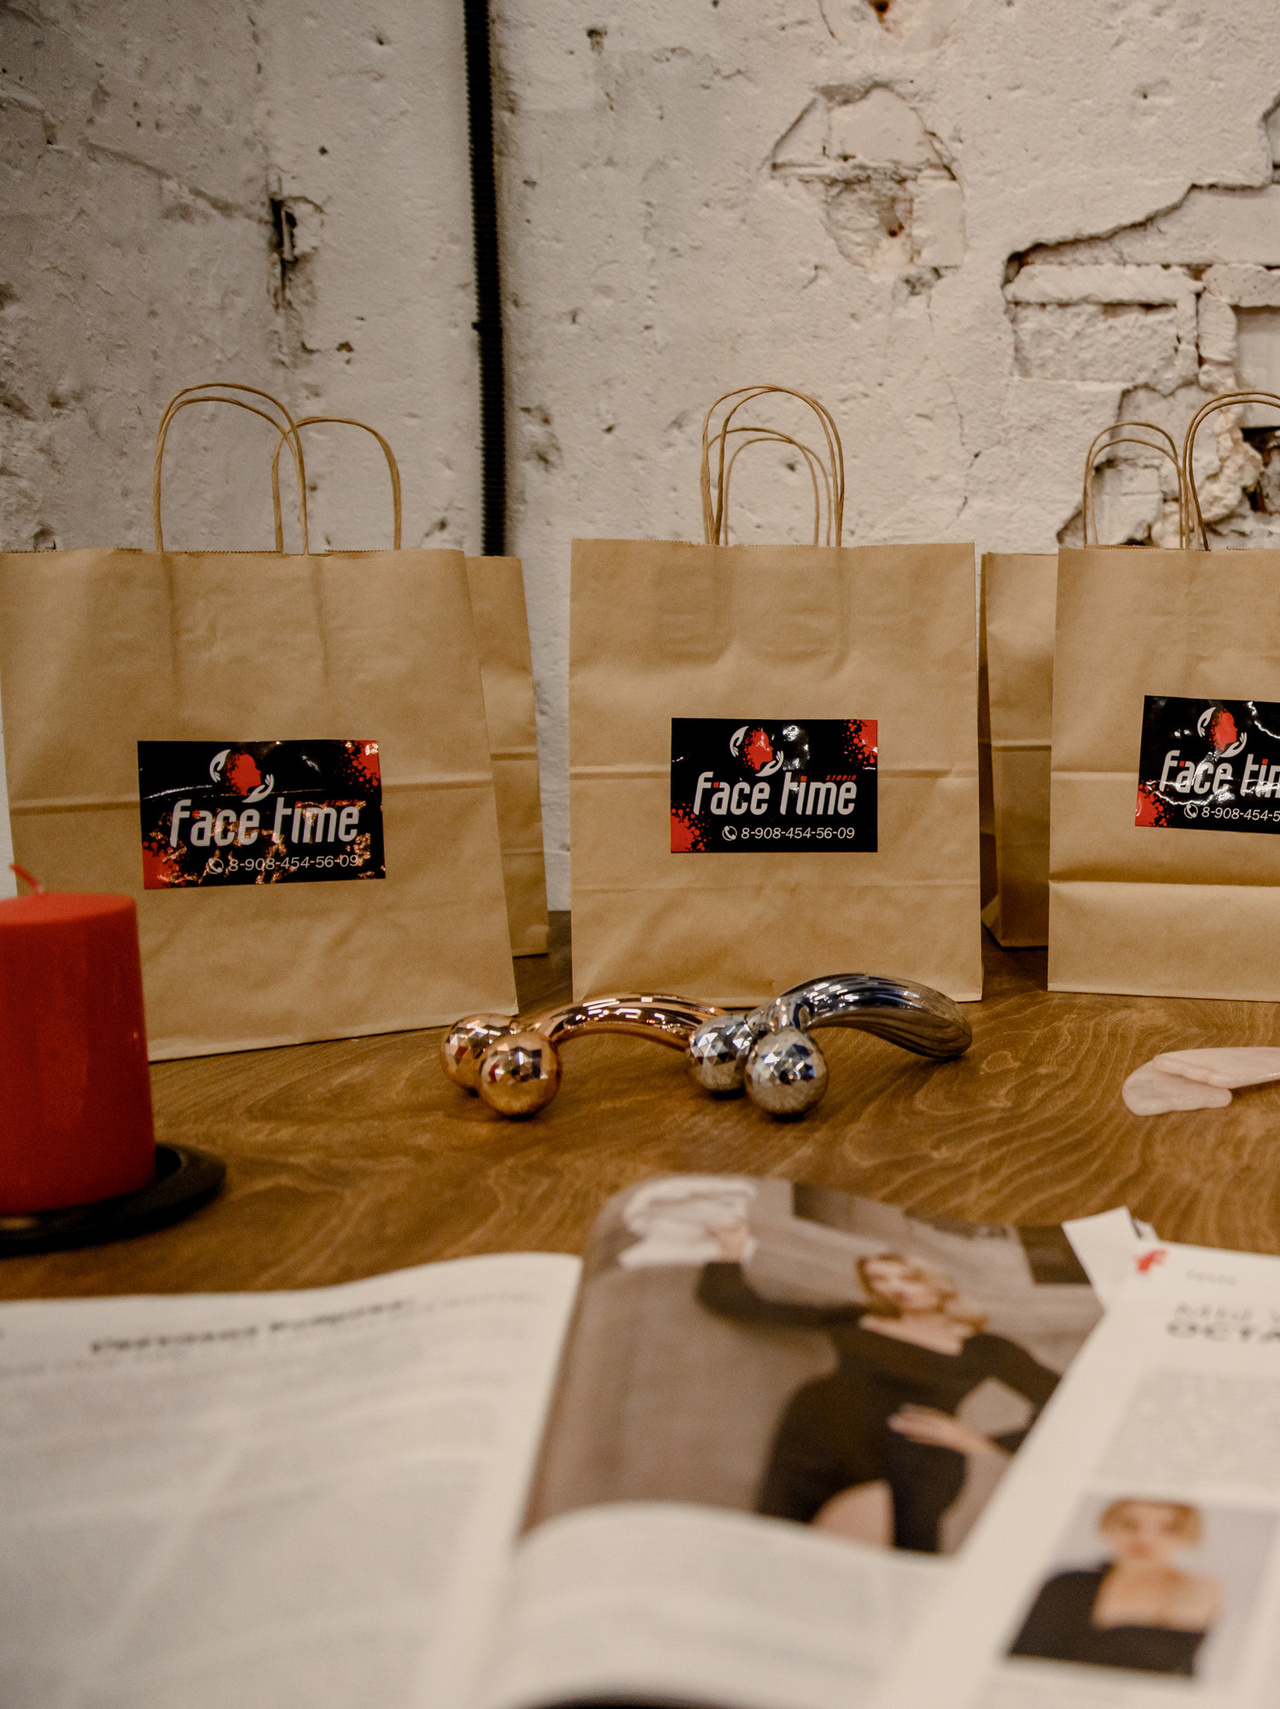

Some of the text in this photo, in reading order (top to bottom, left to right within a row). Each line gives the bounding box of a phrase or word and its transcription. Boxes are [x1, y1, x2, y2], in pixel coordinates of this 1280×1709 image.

[693, 771, 857, 815] face time
[1159, 750, 1234, 794] face
[169, 796, 360, 848] face time
[740, 826, 856, 840] 8-908-454-56-09
[228, 853, 359, 873] 8-908-454-56-09
